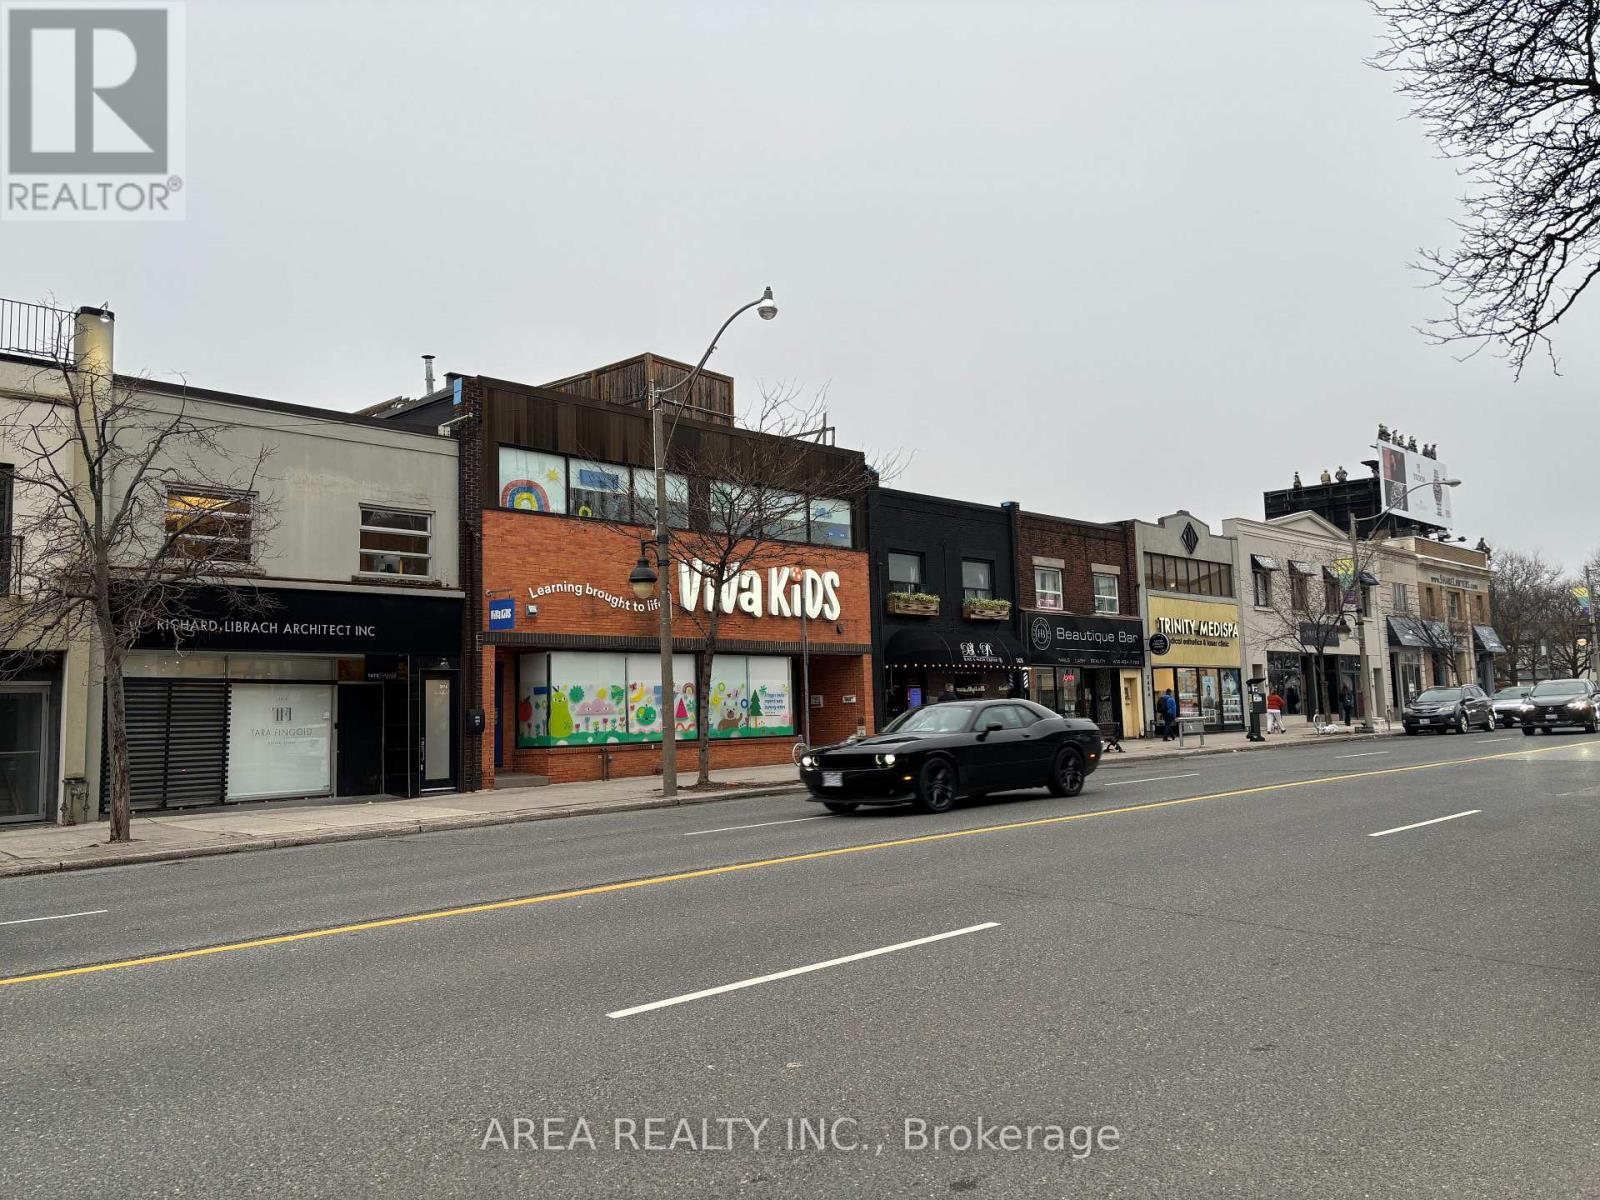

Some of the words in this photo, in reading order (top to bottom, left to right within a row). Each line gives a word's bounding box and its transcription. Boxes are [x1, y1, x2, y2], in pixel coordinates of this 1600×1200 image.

[528, 580, 582, 599] Learning
[585, 583, 630, 611] brought
[633, 601, 645, 612] to
[157, 619, 218, 632] RICHARD
[224, 620, 278, 634] LIBRACH
[283, 622, 351, 637] ARCHITECT
[355, 625, 376, 638] INC
[1056, 627, 1115, 645] Beautique
[1118, 631, 1138, 644] Bar
[1158, 617, 1196, 635] TRINITY
[1199, 620, 1239, 638] MEDISPA
[251, 728, 271, 737] TARA
